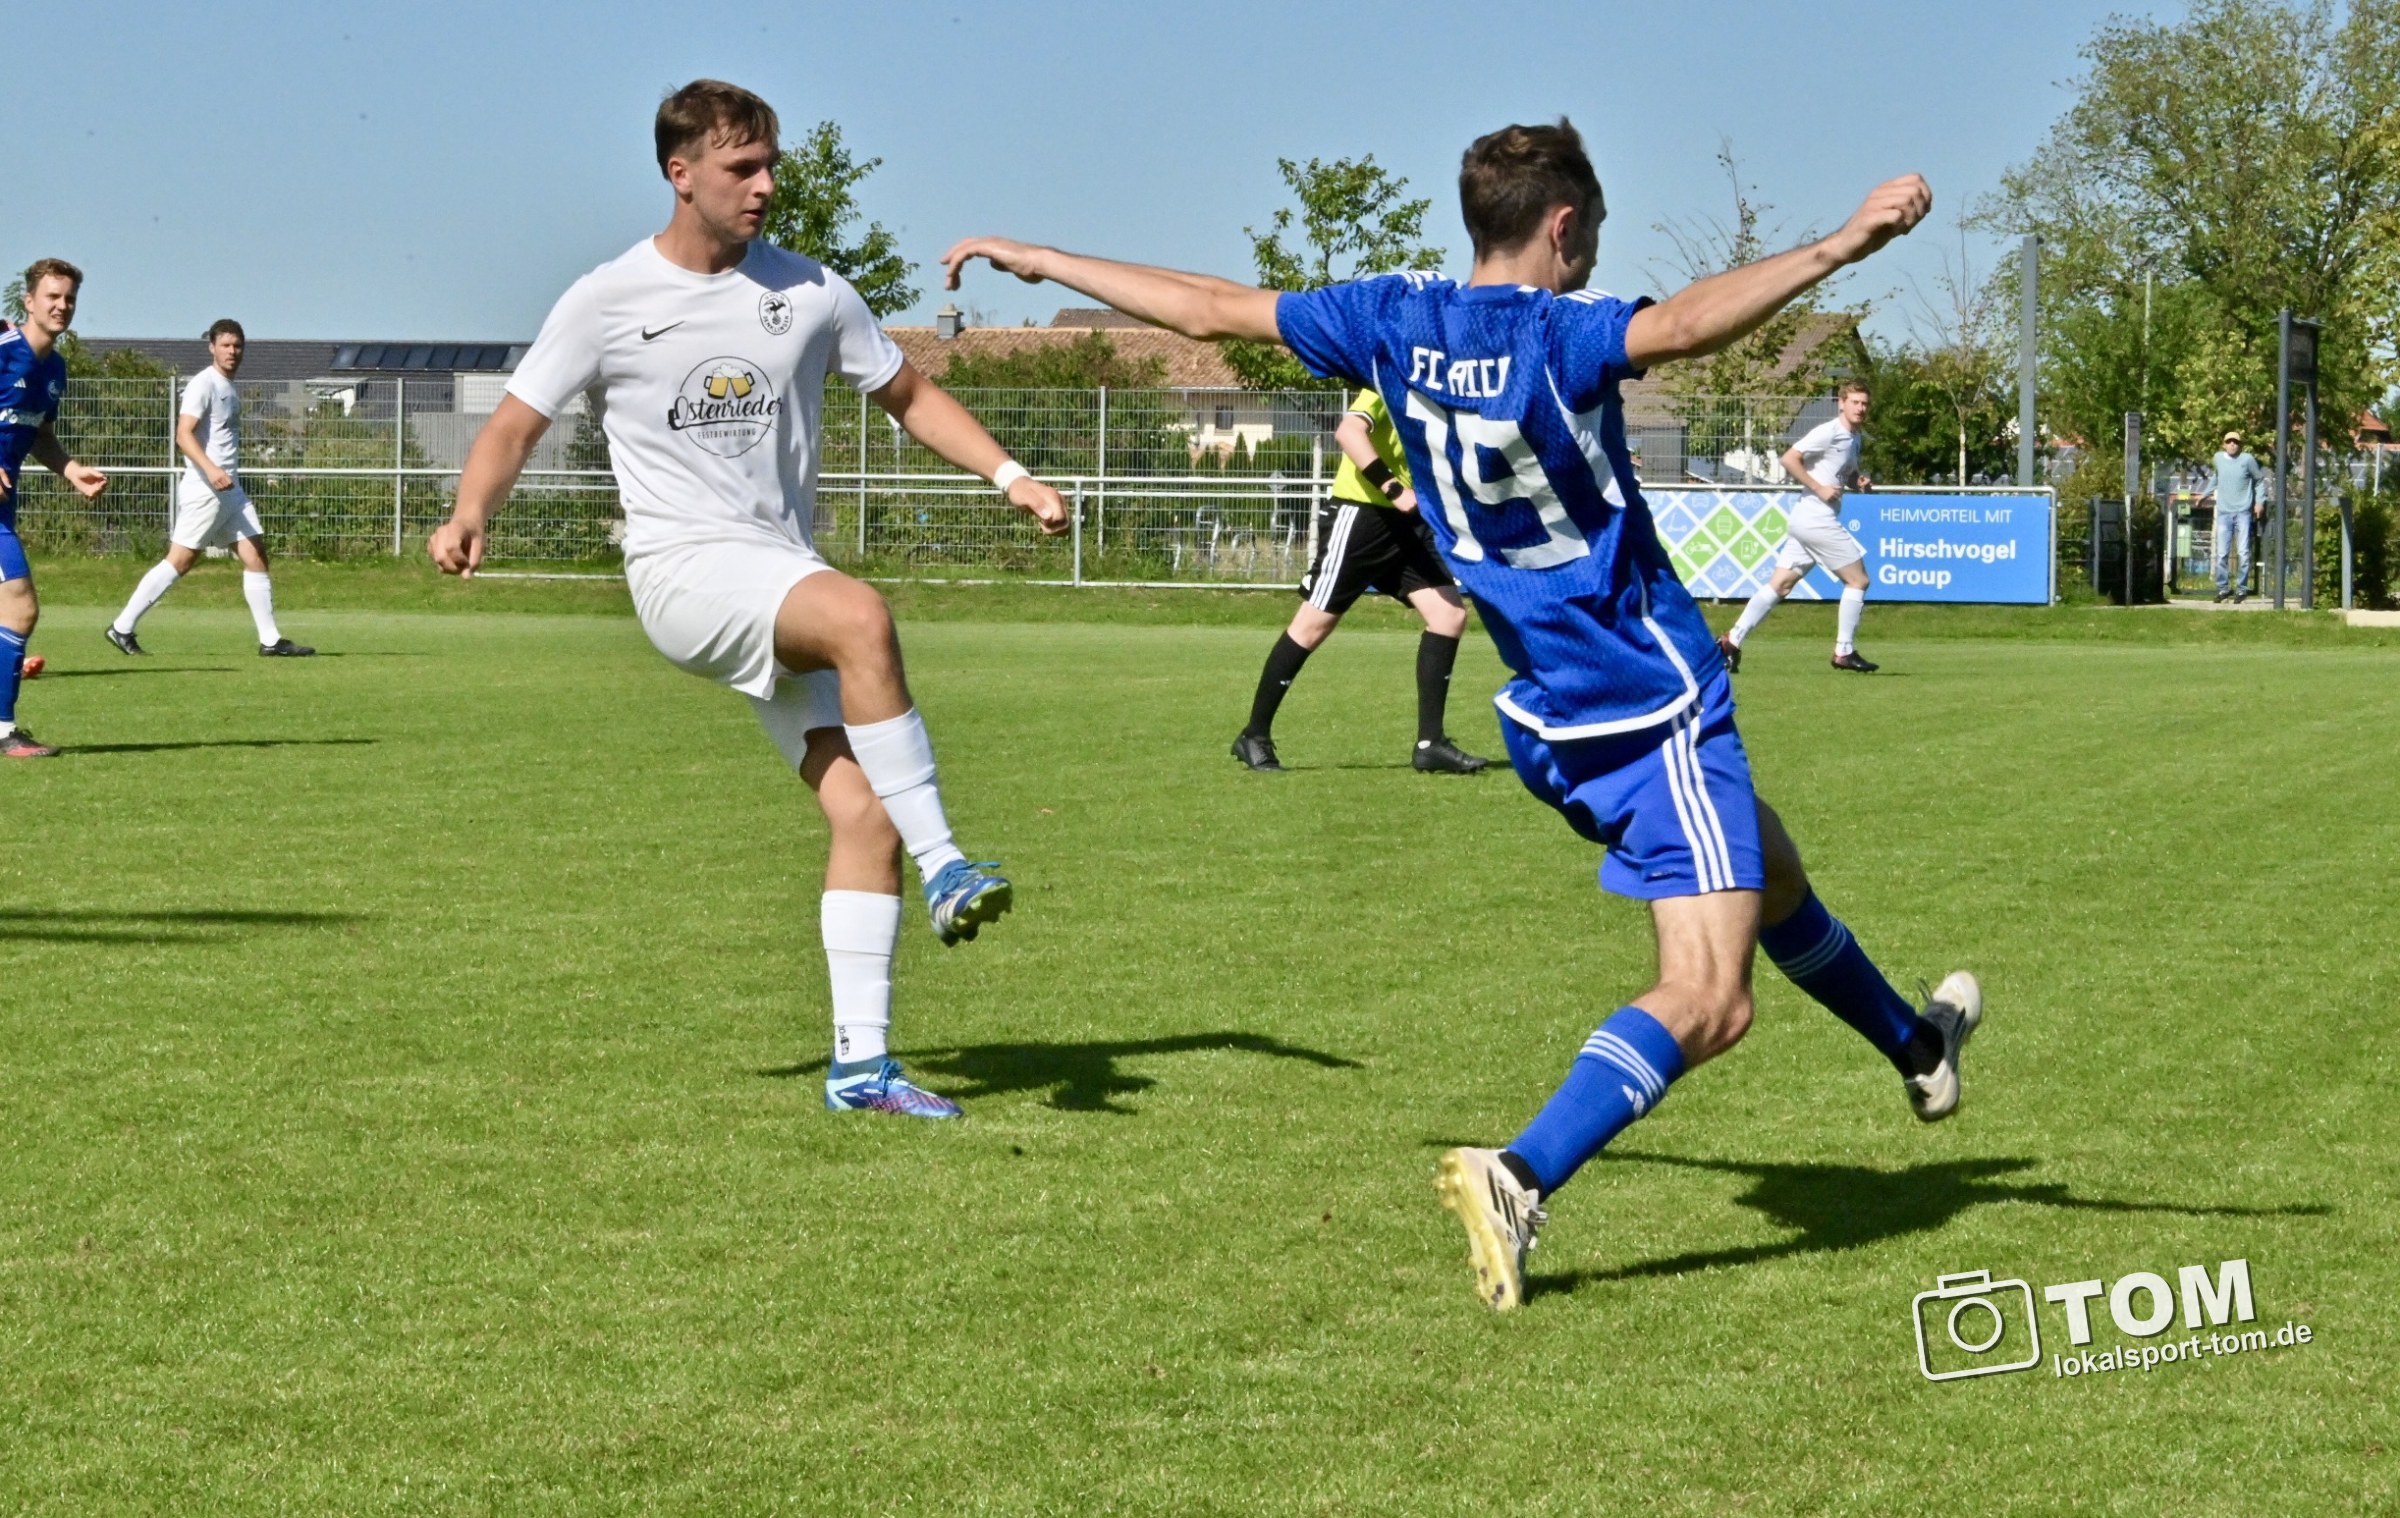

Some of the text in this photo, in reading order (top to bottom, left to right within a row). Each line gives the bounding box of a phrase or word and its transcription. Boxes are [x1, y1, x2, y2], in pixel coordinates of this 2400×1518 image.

[1408, 346, 1445, 391] FC
[667, 394, 783, 431] Ostenrieder
[1406, 390, 1590, 570] 19
[1880, 508, 2012, 524] HEIMVORTEIL MIT
[1879, 537, 2017, 564] Hirschvogel
[1878, 563, 1952, 590] Group
